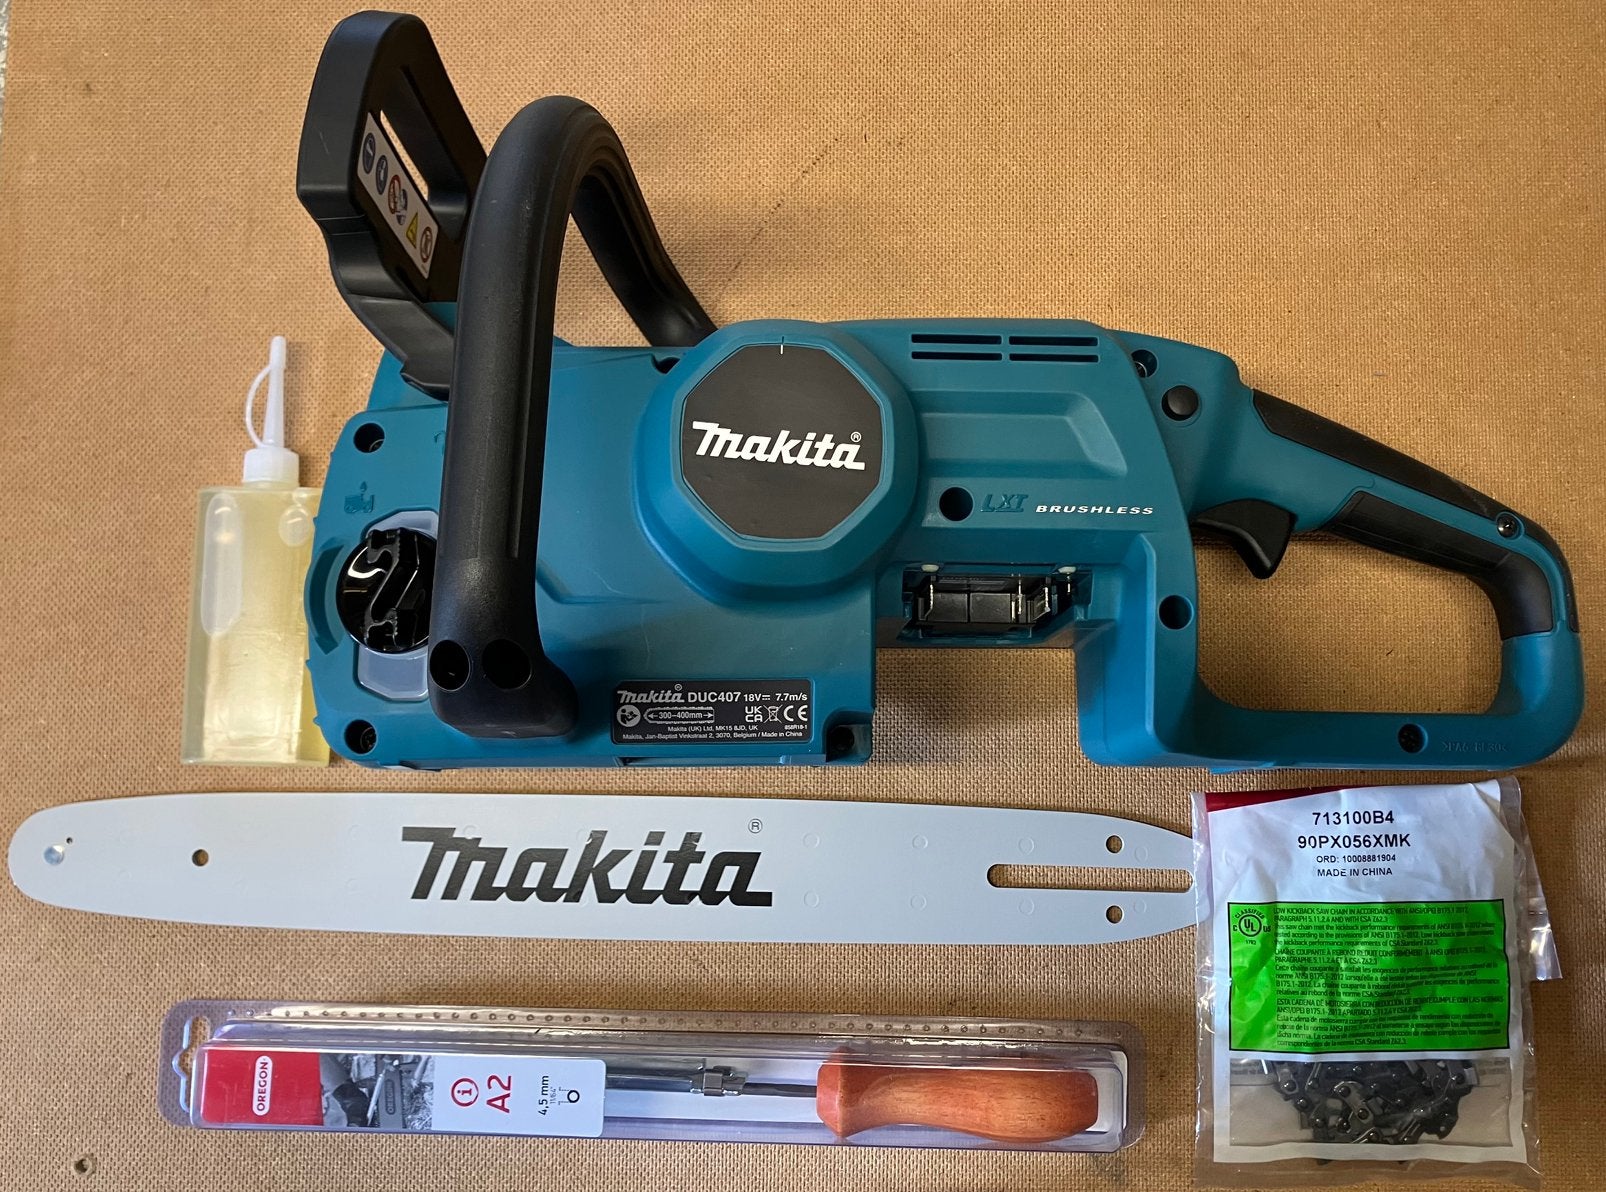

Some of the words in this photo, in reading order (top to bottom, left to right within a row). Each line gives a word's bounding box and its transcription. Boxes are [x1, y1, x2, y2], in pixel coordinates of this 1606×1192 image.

[980, 493, 1029, 512] LXT
[1035, 504, 1154, 515] BRUSHLESS
[687, 692, 742, 703] DUC407
[775, 692, 808, 702] 7.7m/s
[745, 705, 763, 714] UK
[745, 714, 763, 723] CA
[1312, 810, 1394, 825] 713100B4
[1297, 833, 1411, 848] 90PX056XMK
[1316, 855, 1340, 863] ORD:
[1317, 868, 1347, 877] MADE
[1349, 868, 1360, 876] IN
[1362, 867, 1393, 876] CHINA
[1244, 918, 1257, 932] UL
[256, 1061, 269, 1112] OREGON
[541, 1075, 549, 1096] mm
[486, 1074, 512, 1114] A2
[538, 1099, 549, 1116] 4,5
